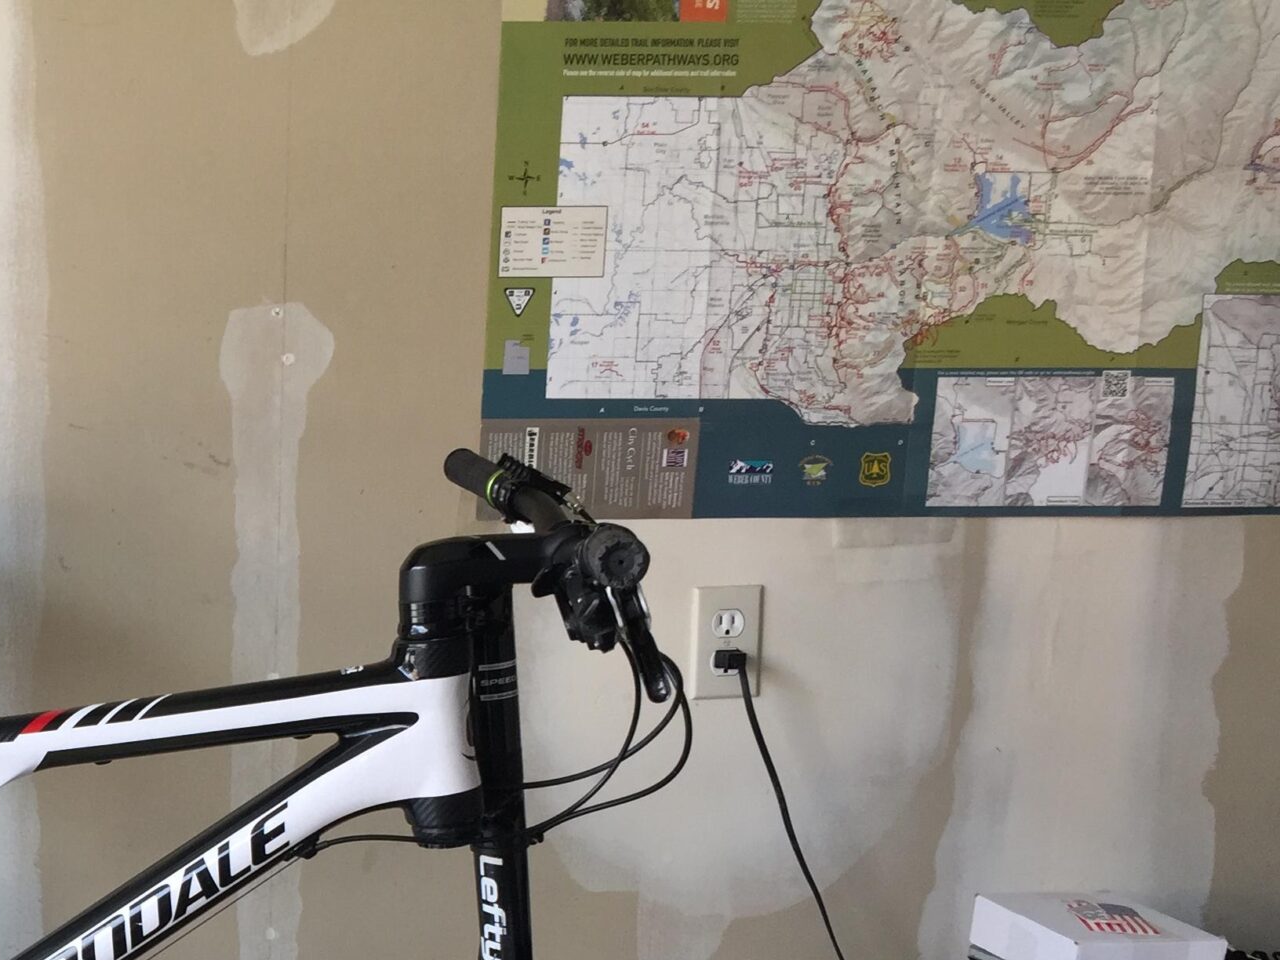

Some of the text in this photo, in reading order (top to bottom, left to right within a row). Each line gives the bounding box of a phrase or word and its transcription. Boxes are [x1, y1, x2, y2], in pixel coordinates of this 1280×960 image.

[564, 38, 578, 48] FOR
[579, 38, 599, 48] MORE
[631, 38, 649, 48] TRAIL
[697, 38, 721, 48] PLEASE
[723, 38, 740, 48] VISIT
